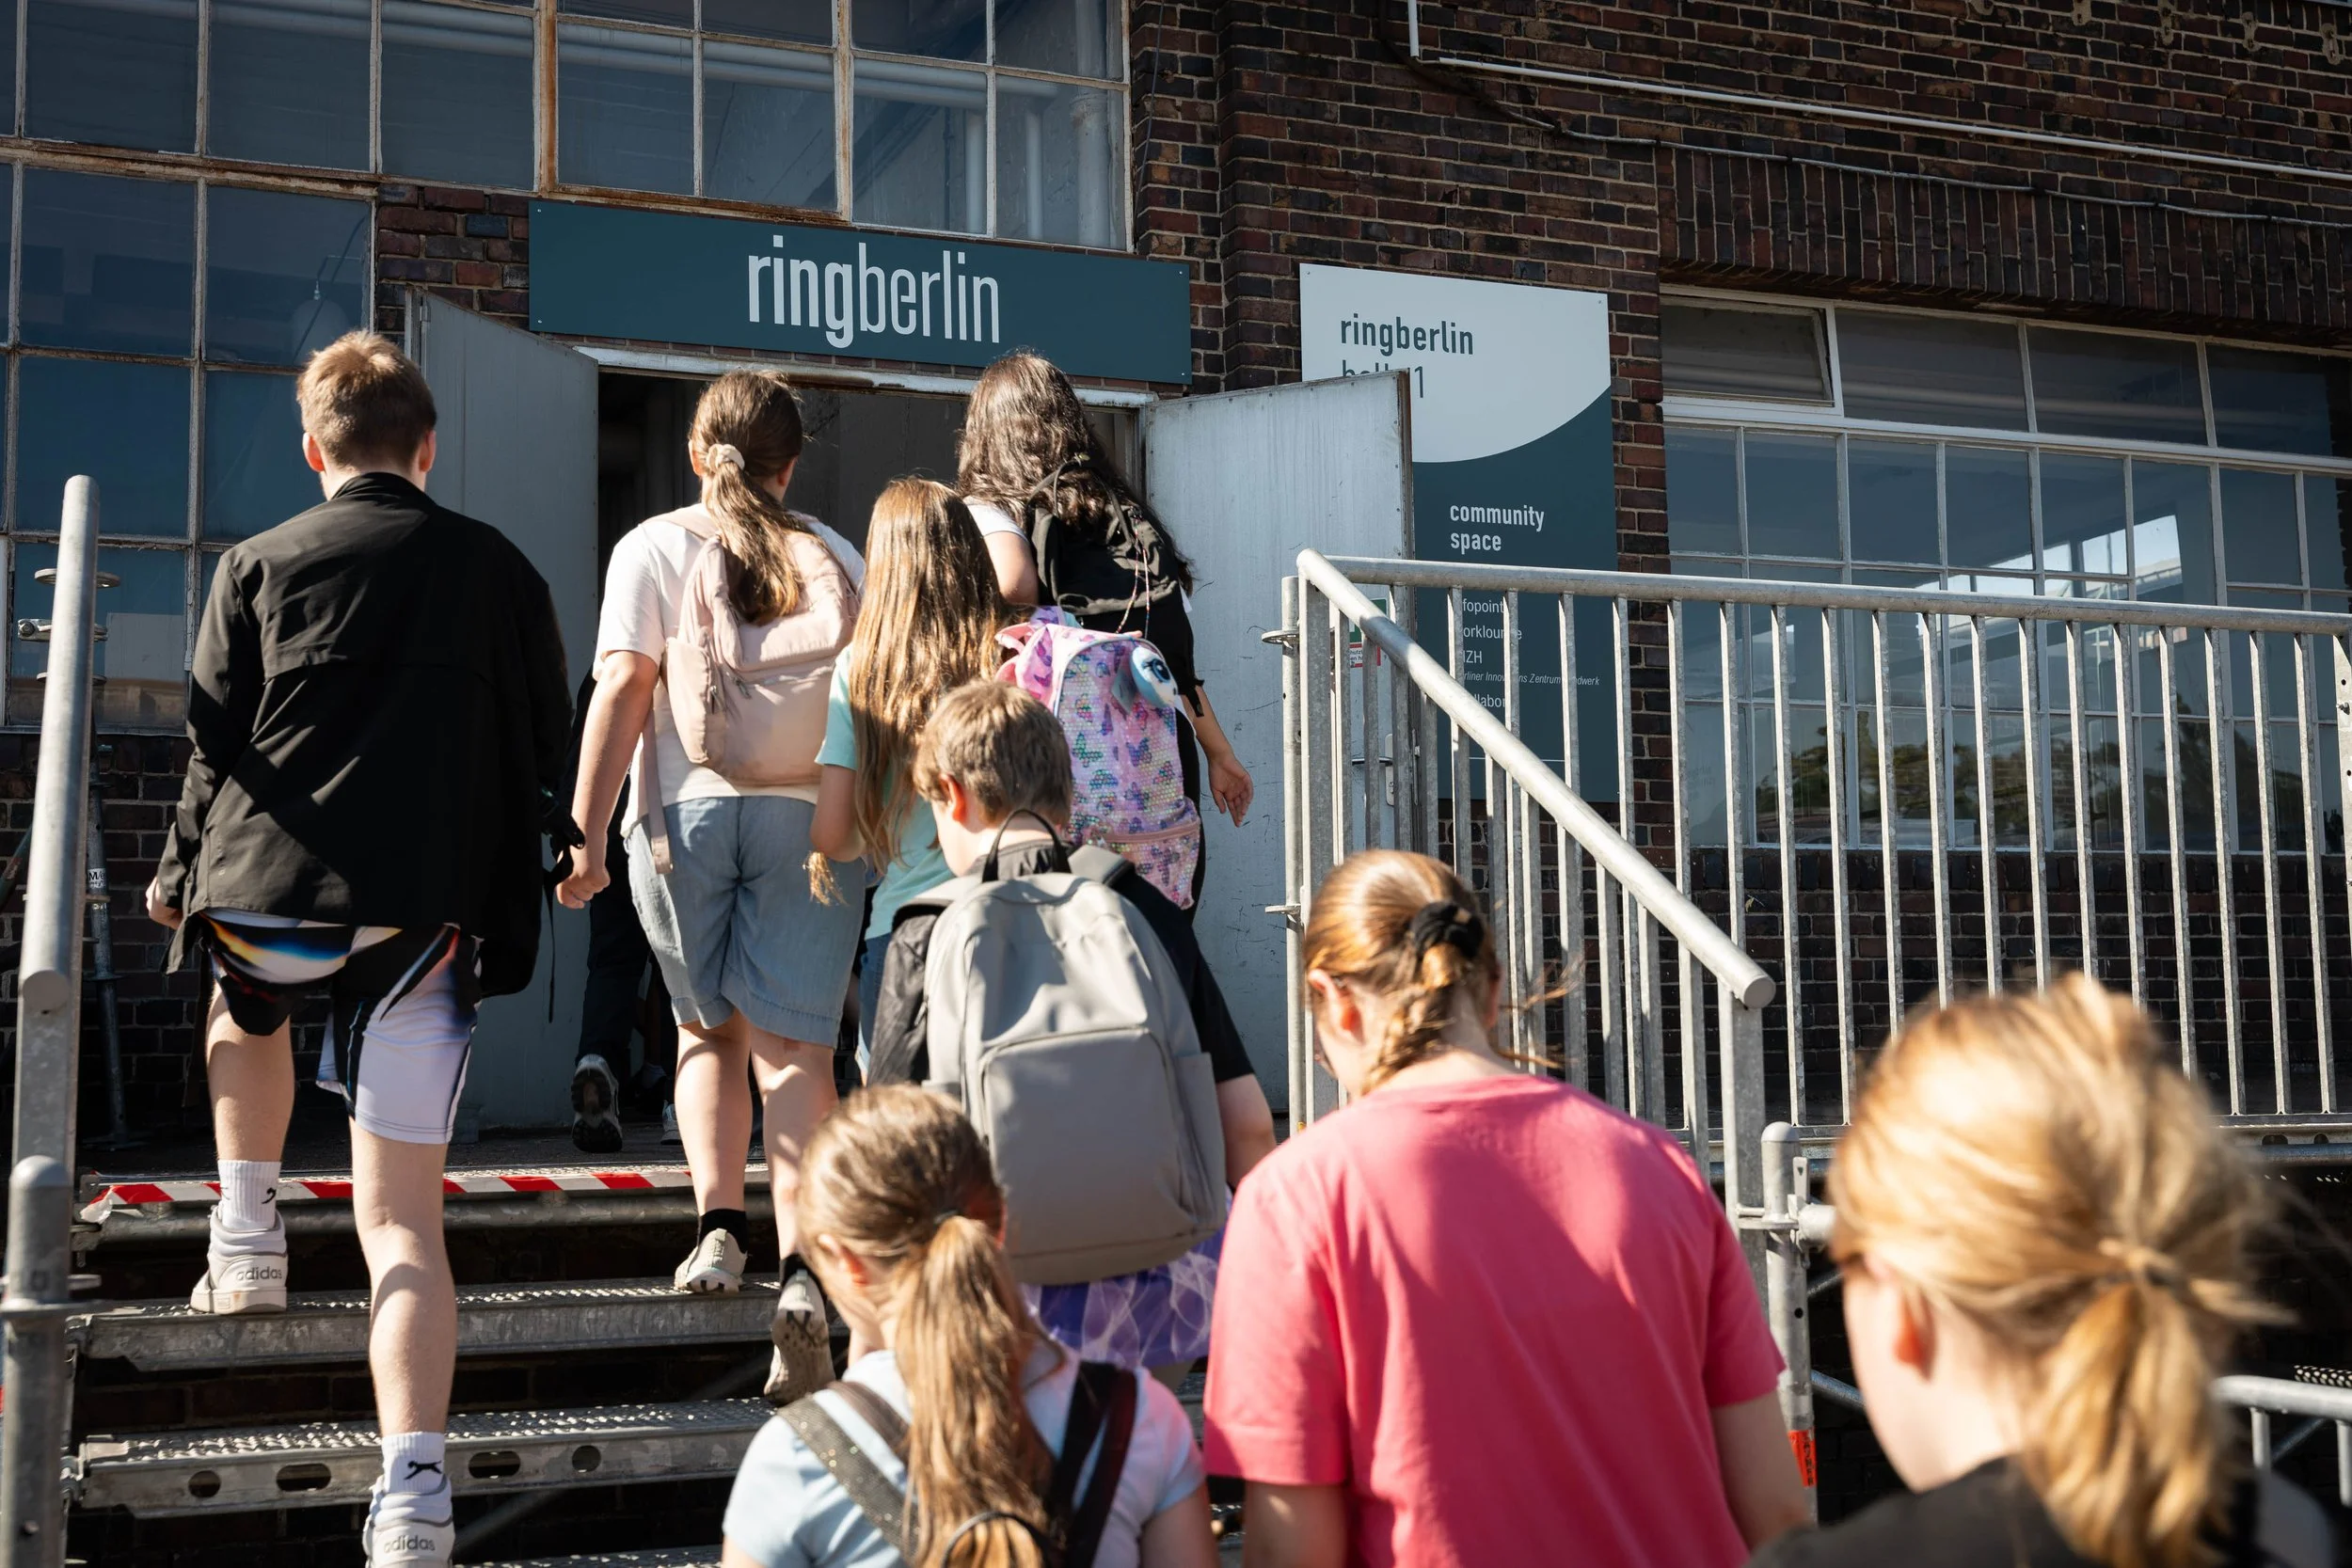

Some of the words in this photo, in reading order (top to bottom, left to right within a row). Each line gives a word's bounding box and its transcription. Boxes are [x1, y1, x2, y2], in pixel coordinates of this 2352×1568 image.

[748, 234, 1000, 349] ringberlin
[1341, 312, 1473, 356] ringberlin
[1414, 367, 1423, 399] 1
[1450, 504, 1545, 532] community
[1450, 531, 1502, 554] space
[1461, 598, 1504, 615] fopoint
[1462, 650, 1483, 664] IZH
[1463, 671, 1485, 682] rliner
[1529, 673, 1561, 685] Zentrum
[237, 1266, 282, 1280] adidas
[384, 1534, 436, 1553] adidas
